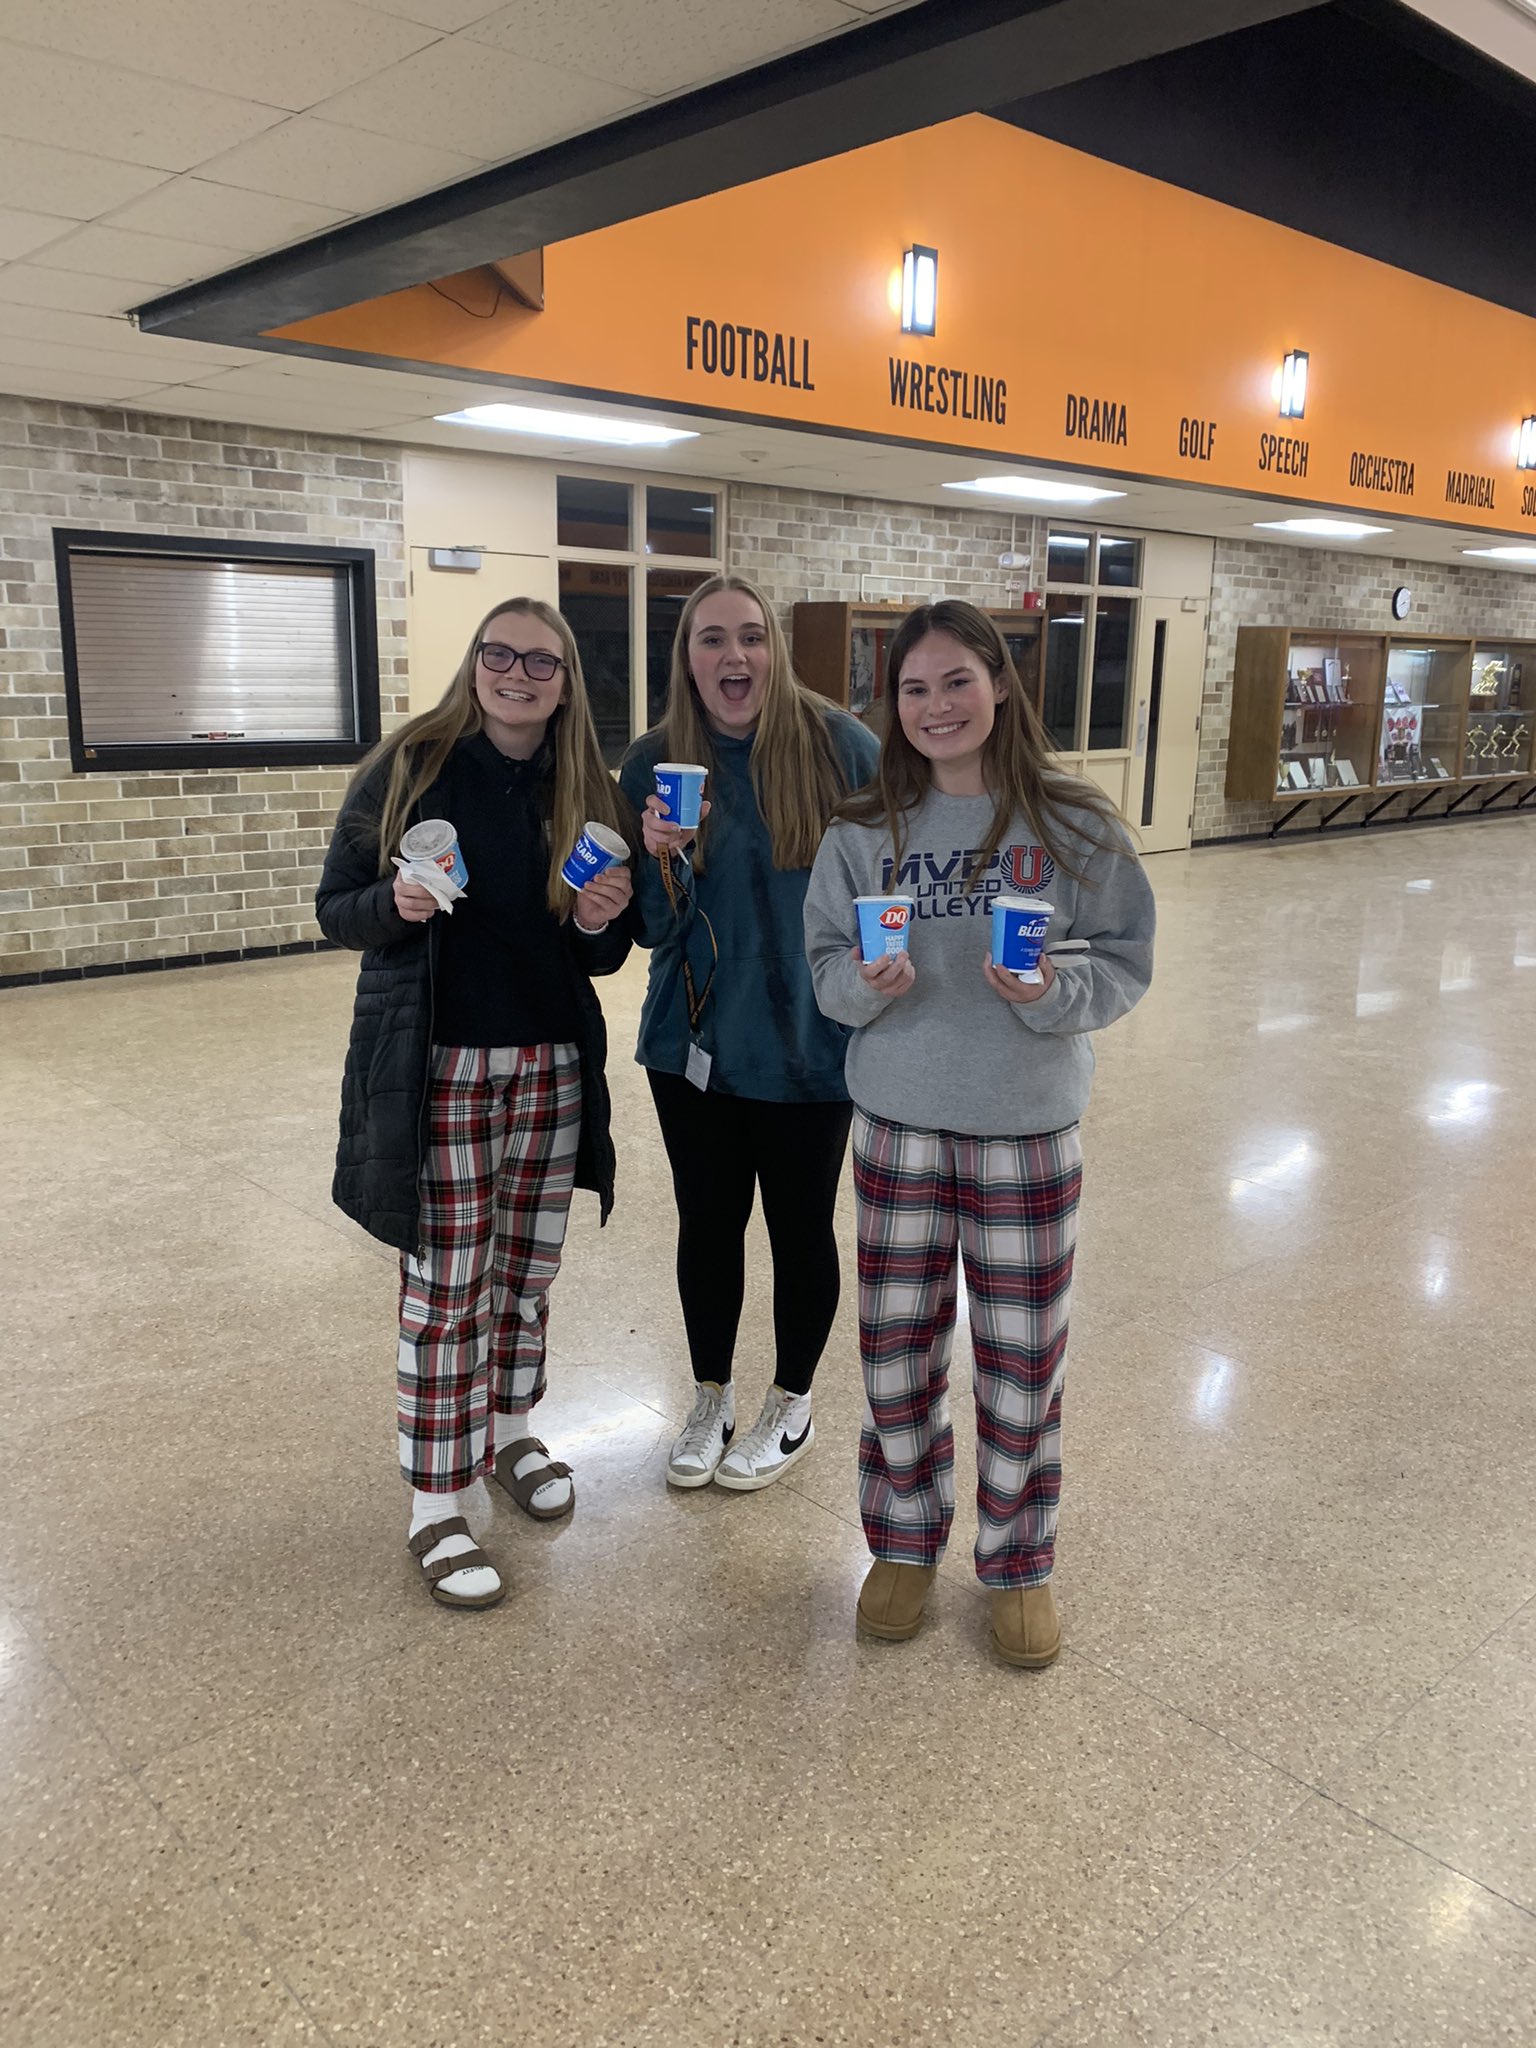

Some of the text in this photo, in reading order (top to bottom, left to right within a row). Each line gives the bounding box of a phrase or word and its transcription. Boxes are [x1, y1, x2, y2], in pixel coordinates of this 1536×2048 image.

[686, 315, 815, 391] FOOTBALL
[889, 357, 1007, 425] WRESTLING
[1065, 393, 1128, 447] DRAMA
[1178, 417, 1217, 461] GOLF
[1258, 432, 1309, 478] SPEECH
[1349, 451, 1415, 496] ORCHESTRA
[1445, 470, 1495, 510] MADRIGAL
[881, 848, 1000, 891] MVP
[916, 879, 1002, 898] UNITED
[885, 910, 907, 925] DQ
